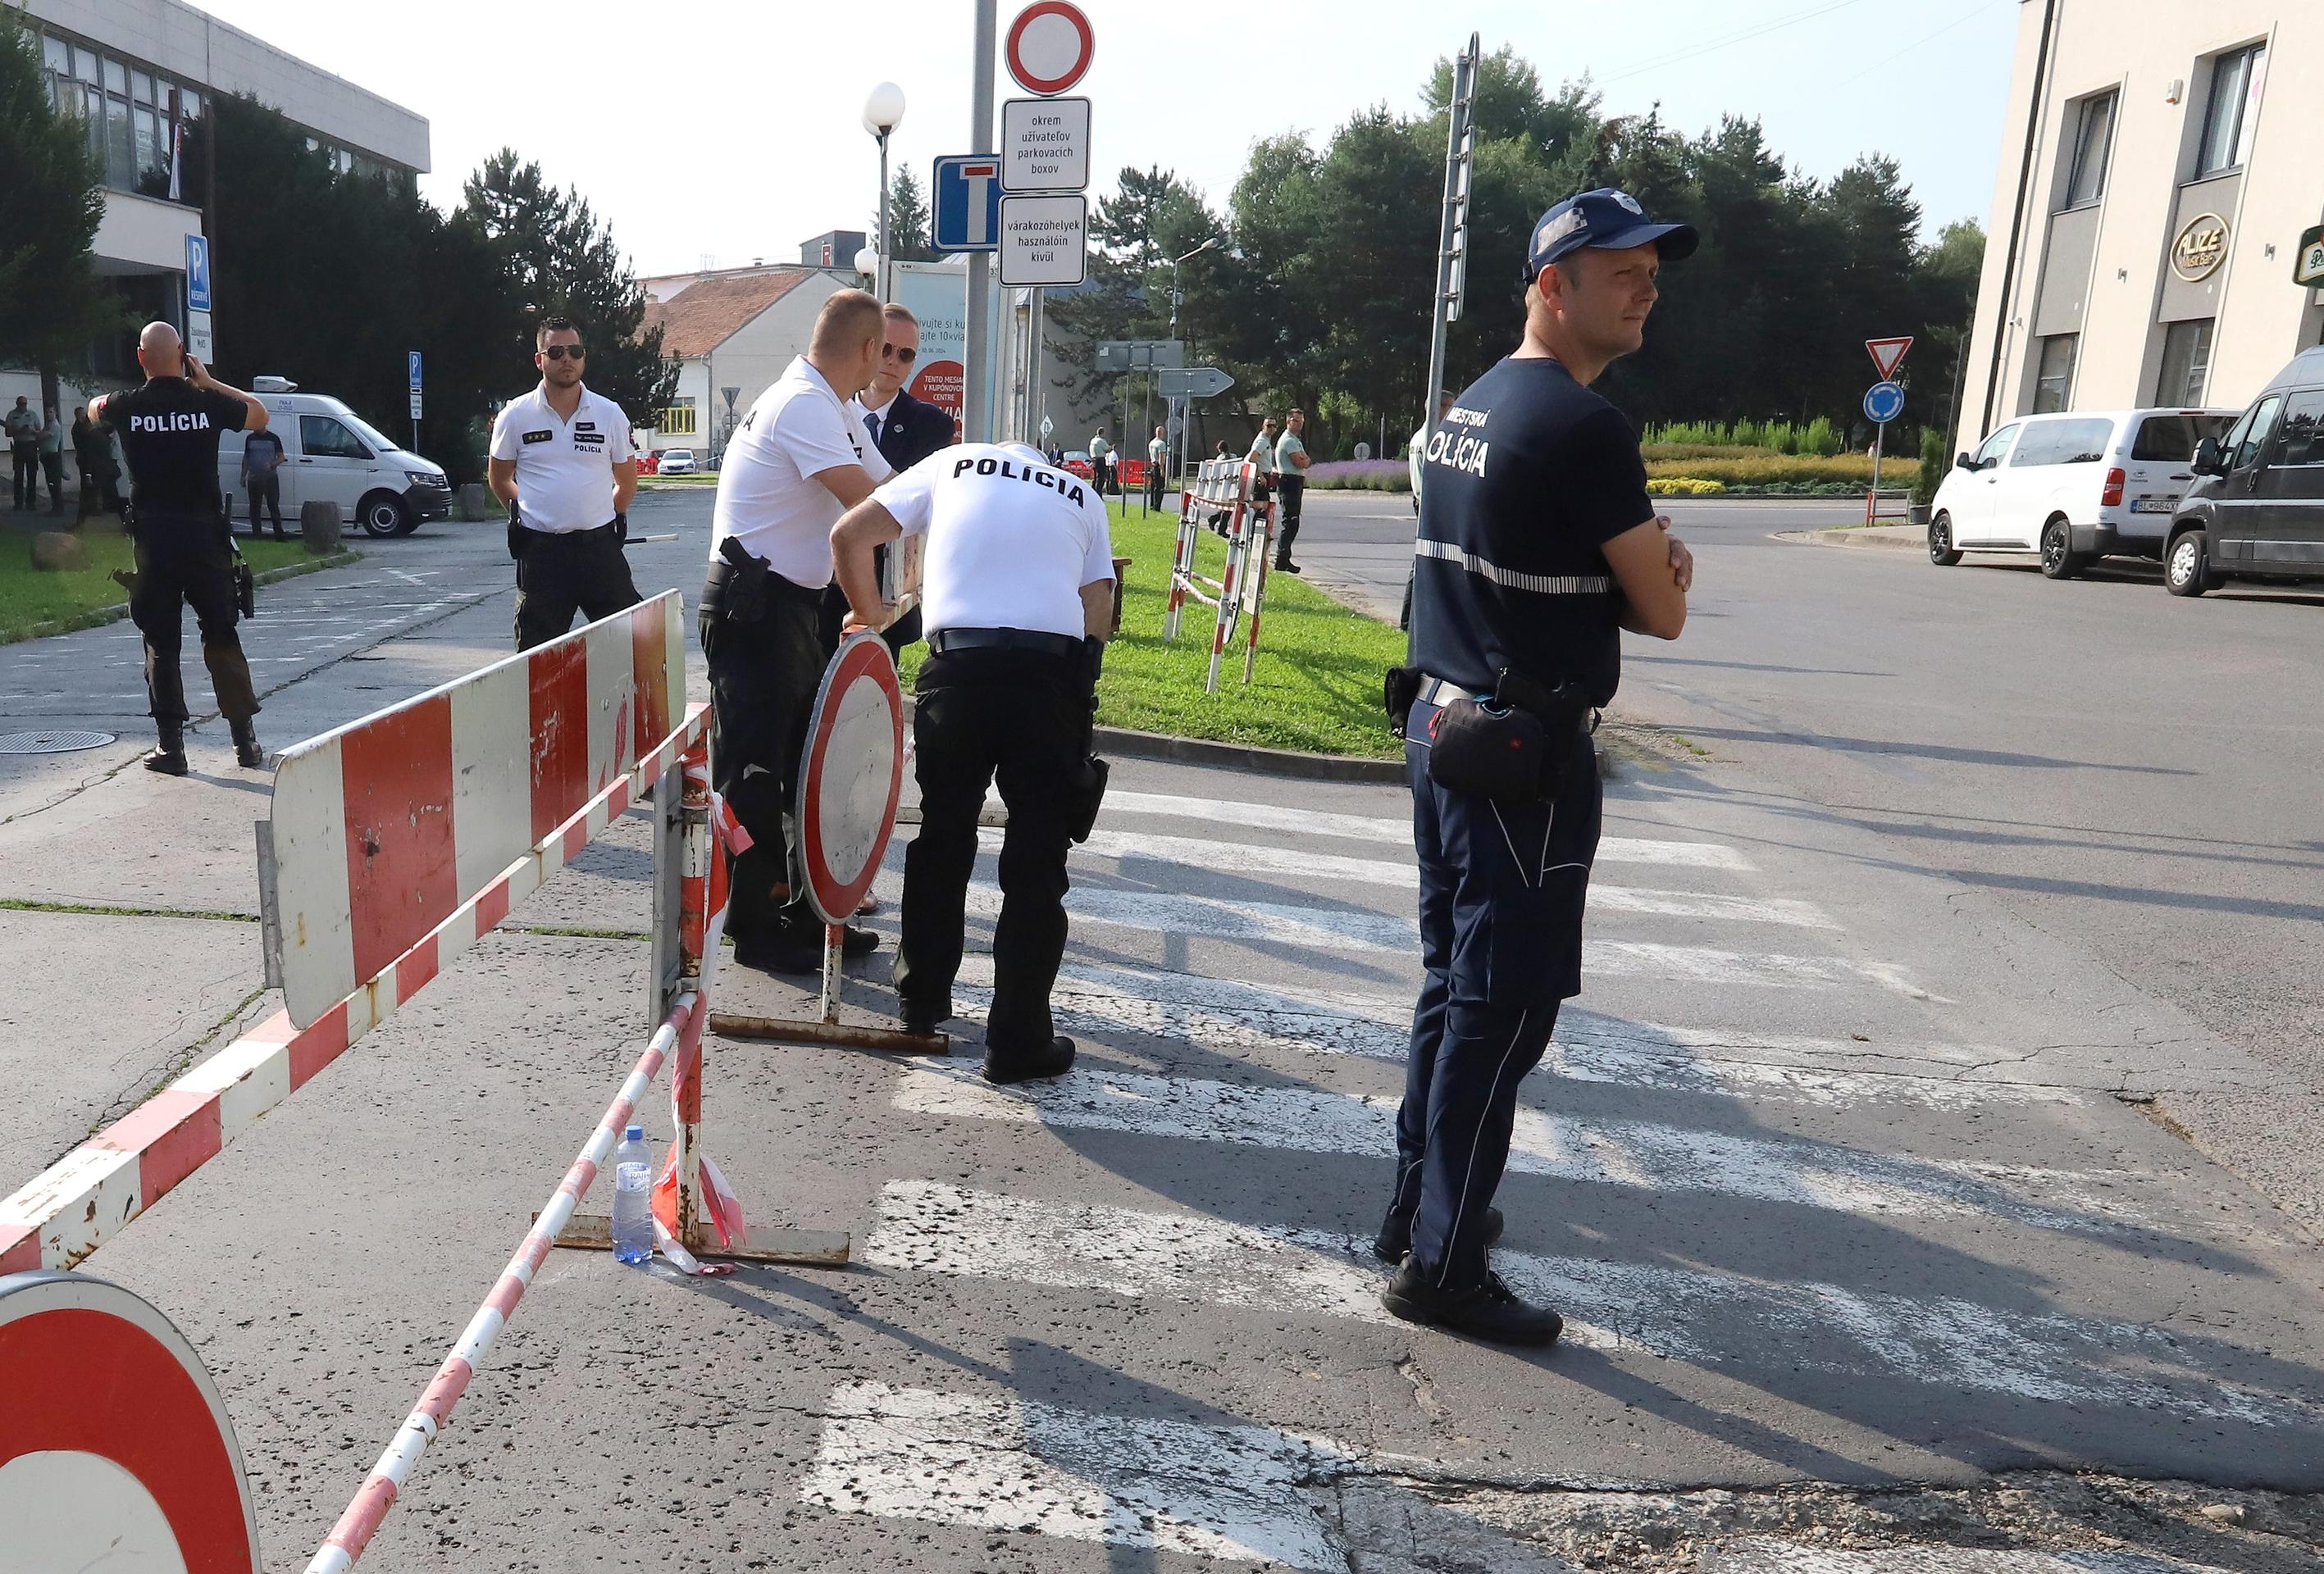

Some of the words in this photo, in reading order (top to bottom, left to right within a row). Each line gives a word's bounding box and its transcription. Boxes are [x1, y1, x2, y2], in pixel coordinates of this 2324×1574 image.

[1032, 116, 1061, 125] okrem
[1022, 130, 1070, 142] užívateľov
[1018, 147, 1073, 160] parkovacích
[1031, 164, 1059, 174] boxov
[1008, 220, 1080, 233] várakozóhelyek
[1018, 235, 1068, 246] használóin
[193, 241, 203, 282] P
[919, 318, 942, 330] ivujte
[955, 320, 965, 329] ku
[920, 331, 936, 342] ajte
[412, 355, 418, 374] P
[130, 412, 210, 432] POLÍCIA
[1446, 407, 1491, 427] MESTSKÁ
[574, 444, 601, 453] POLÍCIA
[1426, 427, 1489, 478] OLÍCIA
[953, 458, 1085, 509] POLÍCIA
